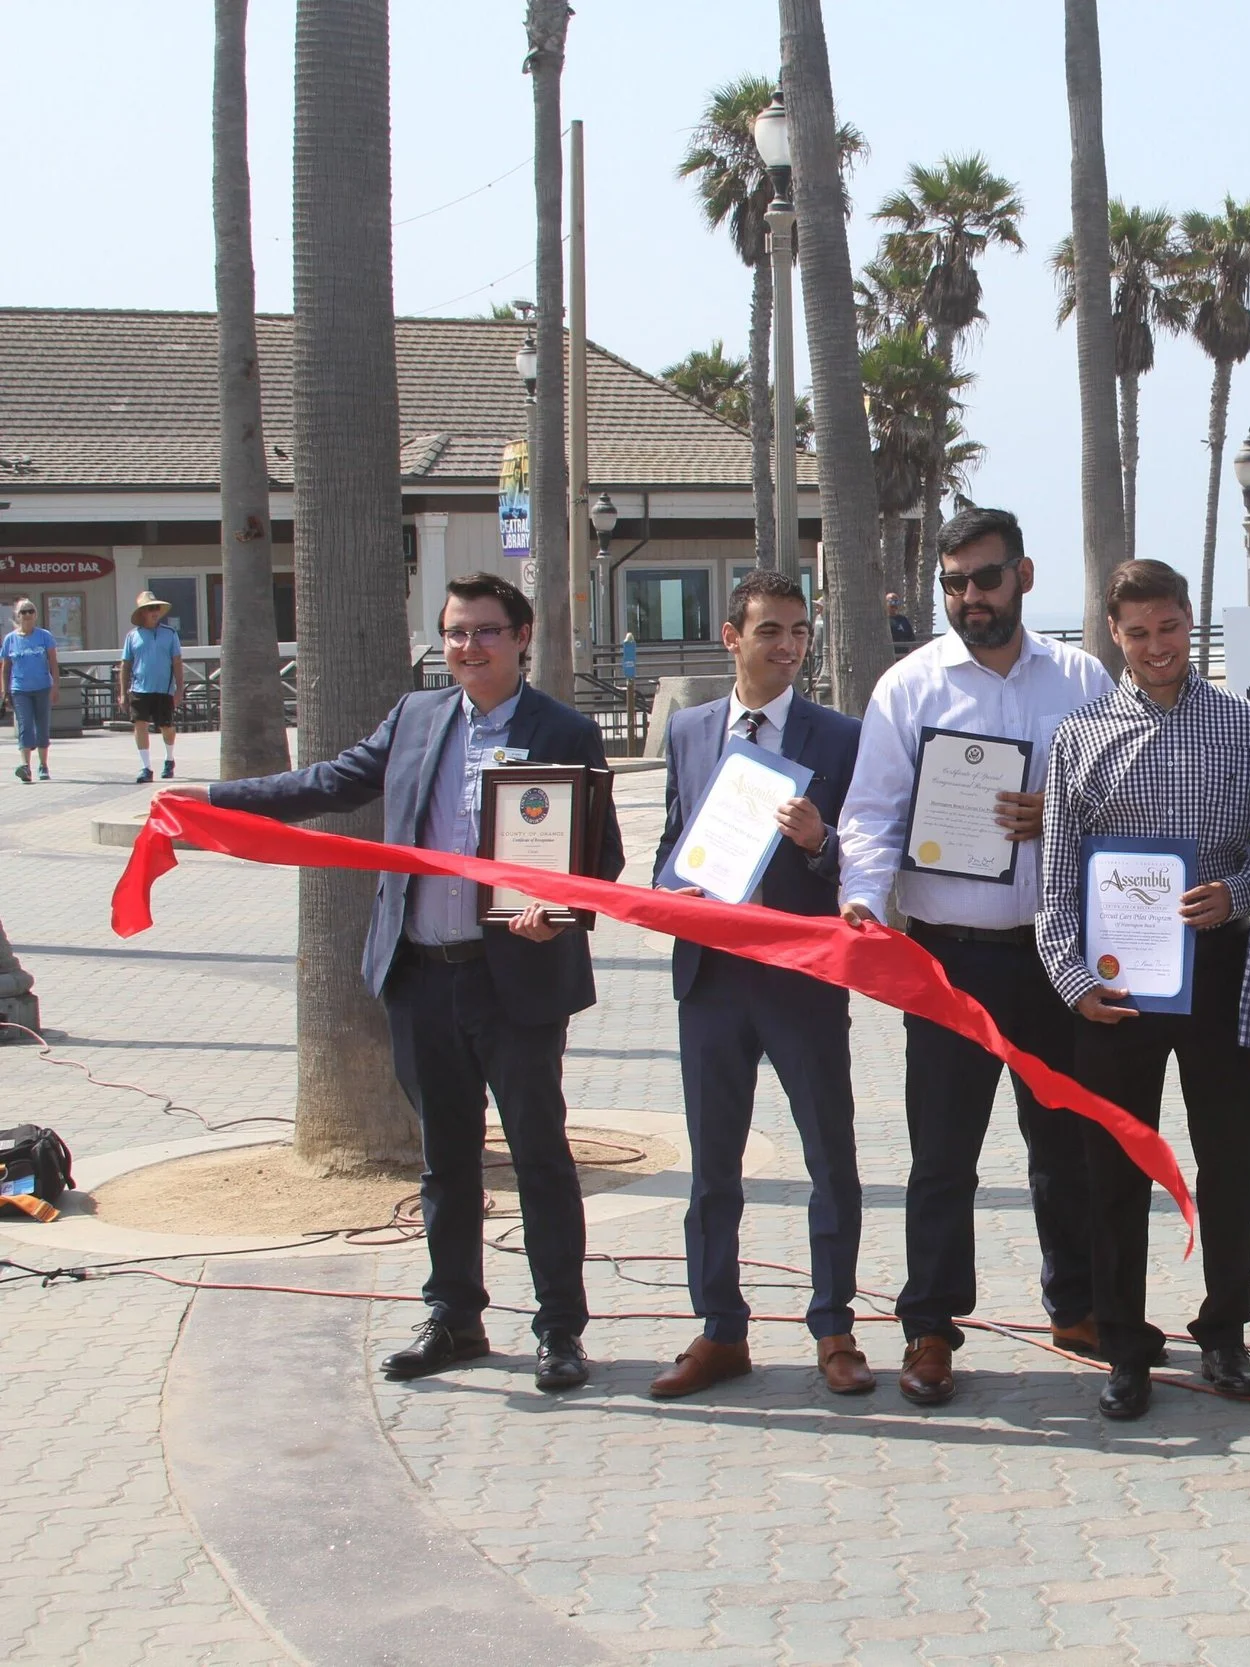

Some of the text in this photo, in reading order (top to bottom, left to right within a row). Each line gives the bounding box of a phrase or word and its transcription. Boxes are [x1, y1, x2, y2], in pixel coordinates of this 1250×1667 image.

[501, 533, 530, 549] LIBRARY
[20, 562, 76, 573] BAREFOOT
[78, 562, 101, 573] BAR
[1100, 867, 1171, 894] Assembly
